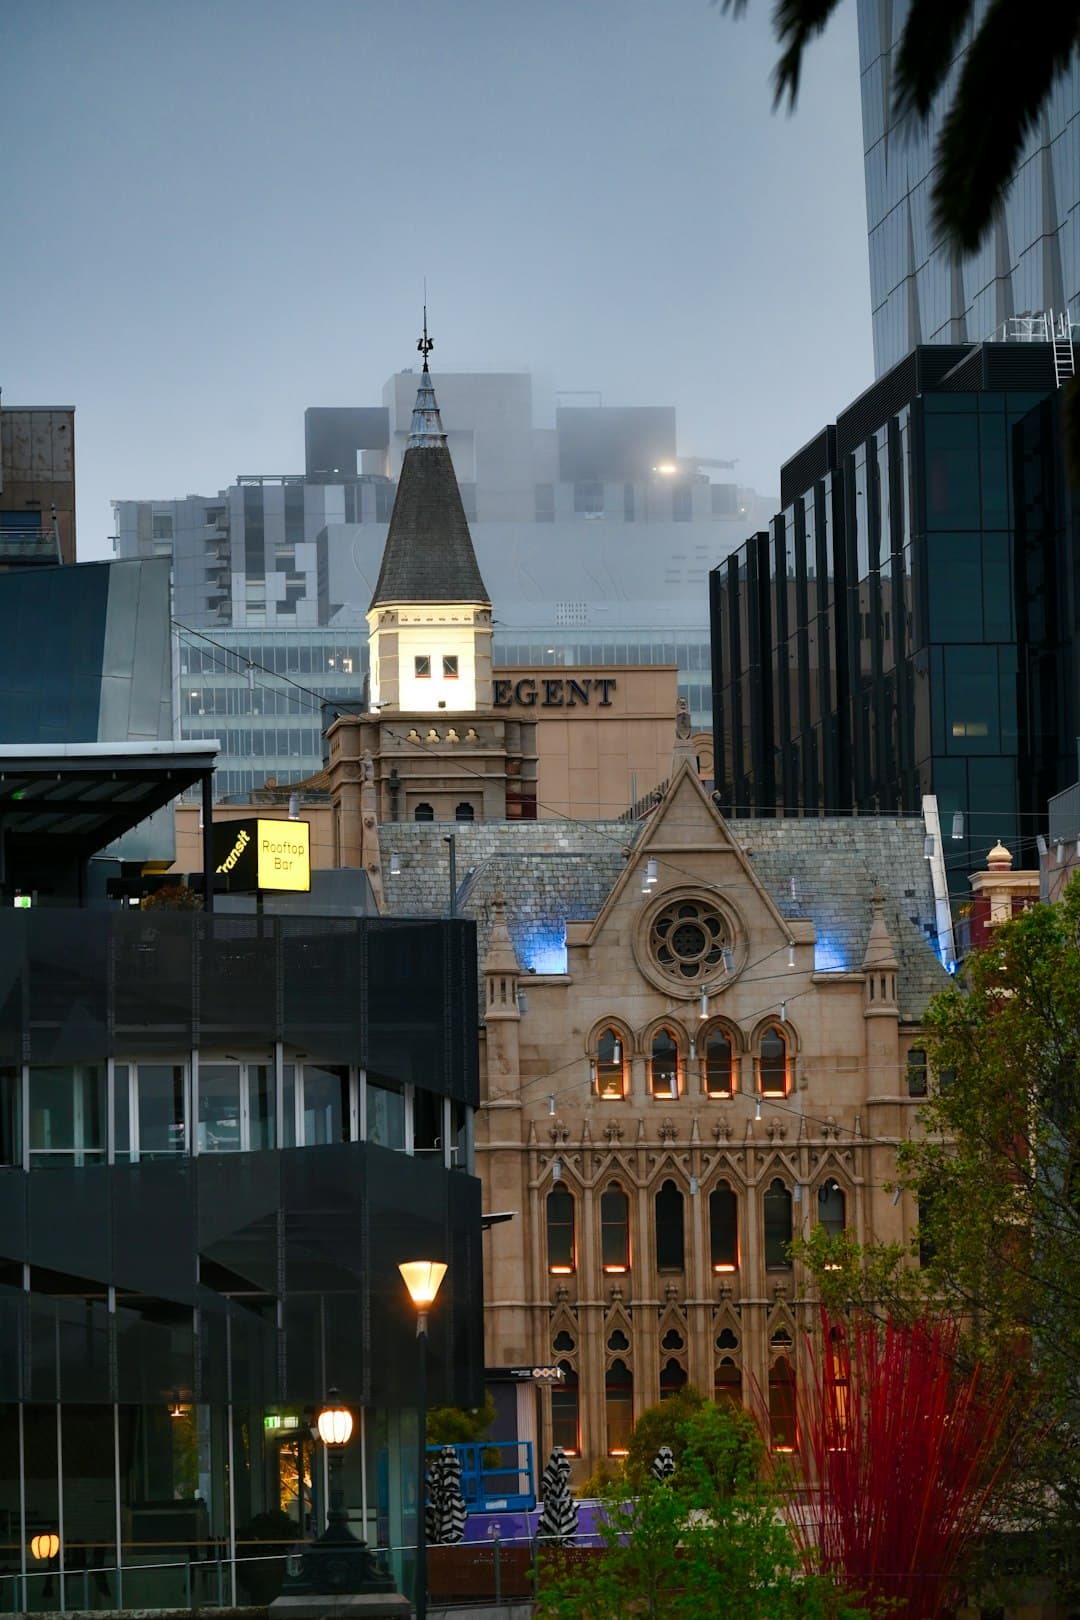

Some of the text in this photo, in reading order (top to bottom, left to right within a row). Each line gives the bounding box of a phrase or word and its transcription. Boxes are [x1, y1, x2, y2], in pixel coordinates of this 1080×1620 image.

[493, 679, 617, 706] EGENT
[262, 839, 305, 857] Rooftop
[274, 857, 293, 870] Bar
